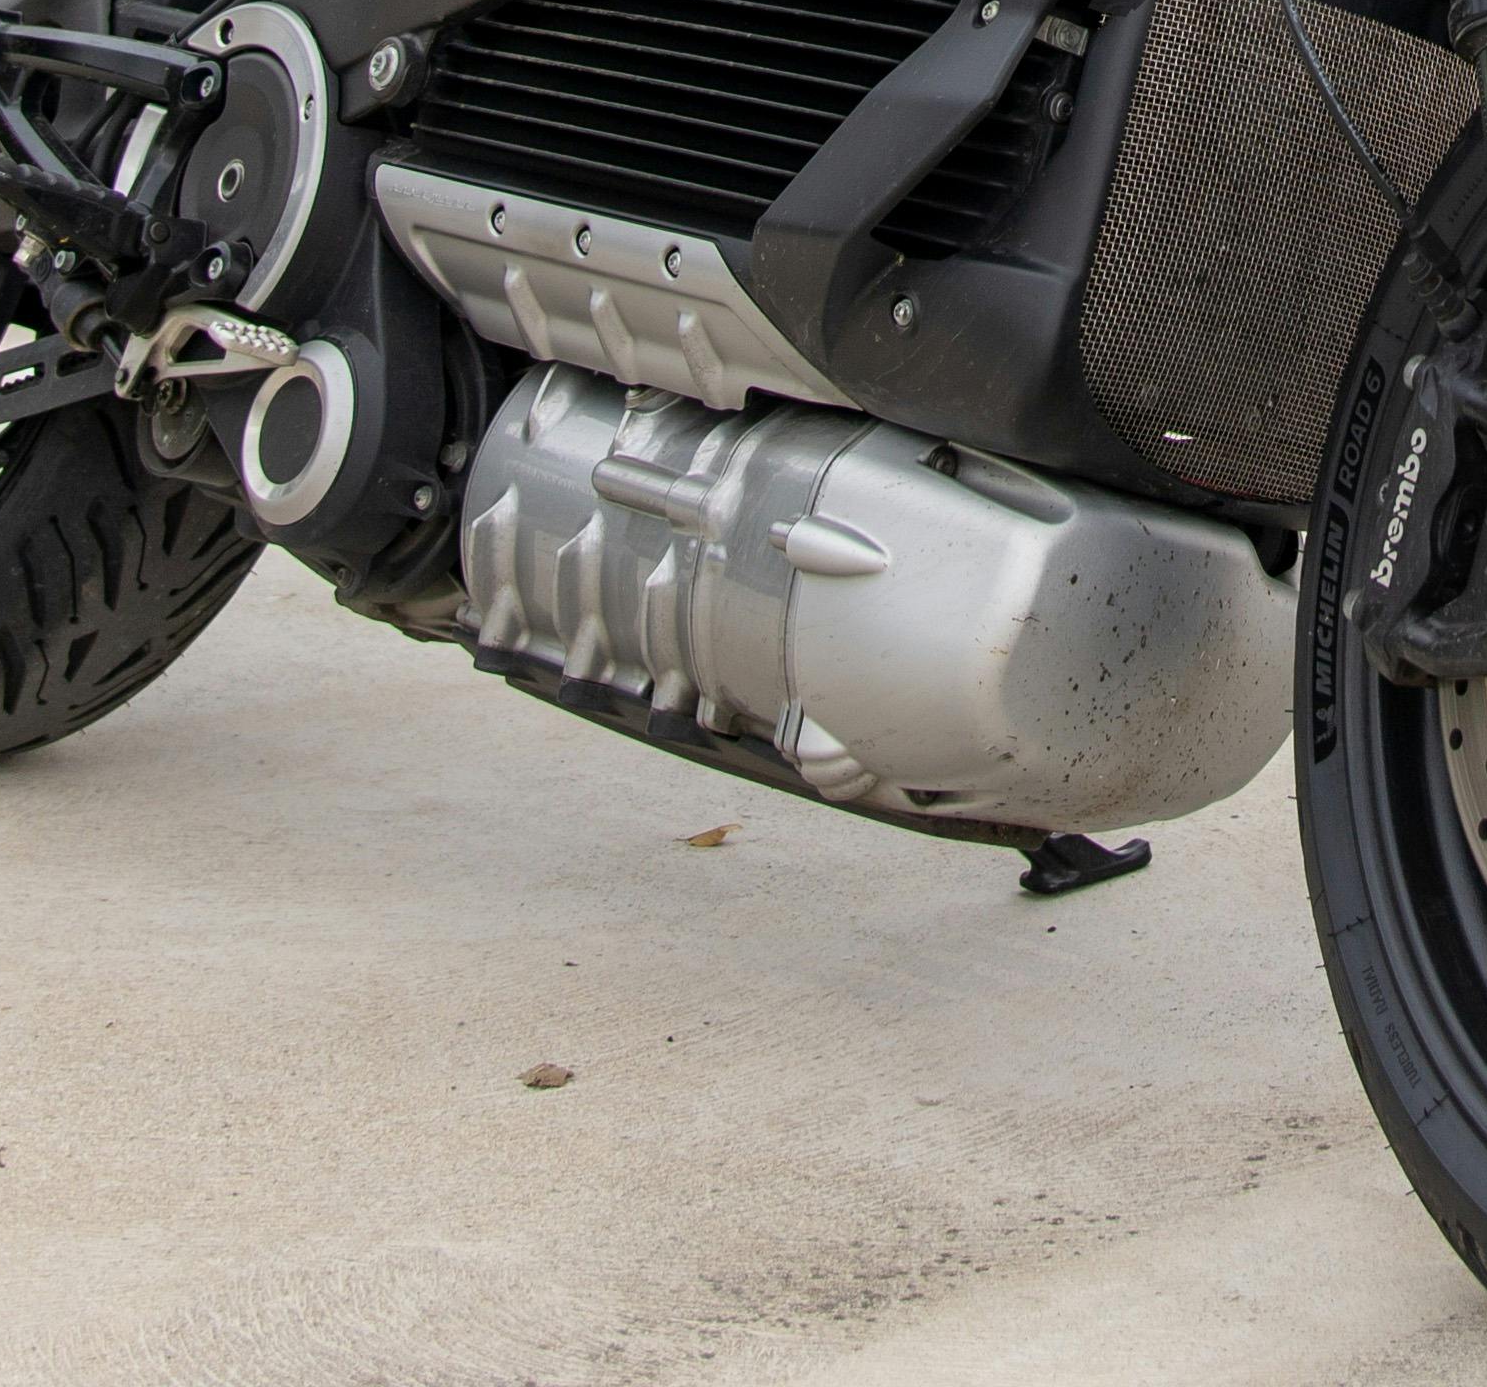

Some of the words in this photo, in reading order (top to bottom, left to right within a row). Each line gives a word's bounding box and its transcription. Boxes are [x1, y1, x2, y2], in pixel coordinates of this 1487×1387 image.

[1316, 523, 1346, 702] MICHELIN
[1338, 405, 1373, 491] ROAD
[1369, 373, 1382, 394] 6
[1370, 427, 1427, 588] brembo
